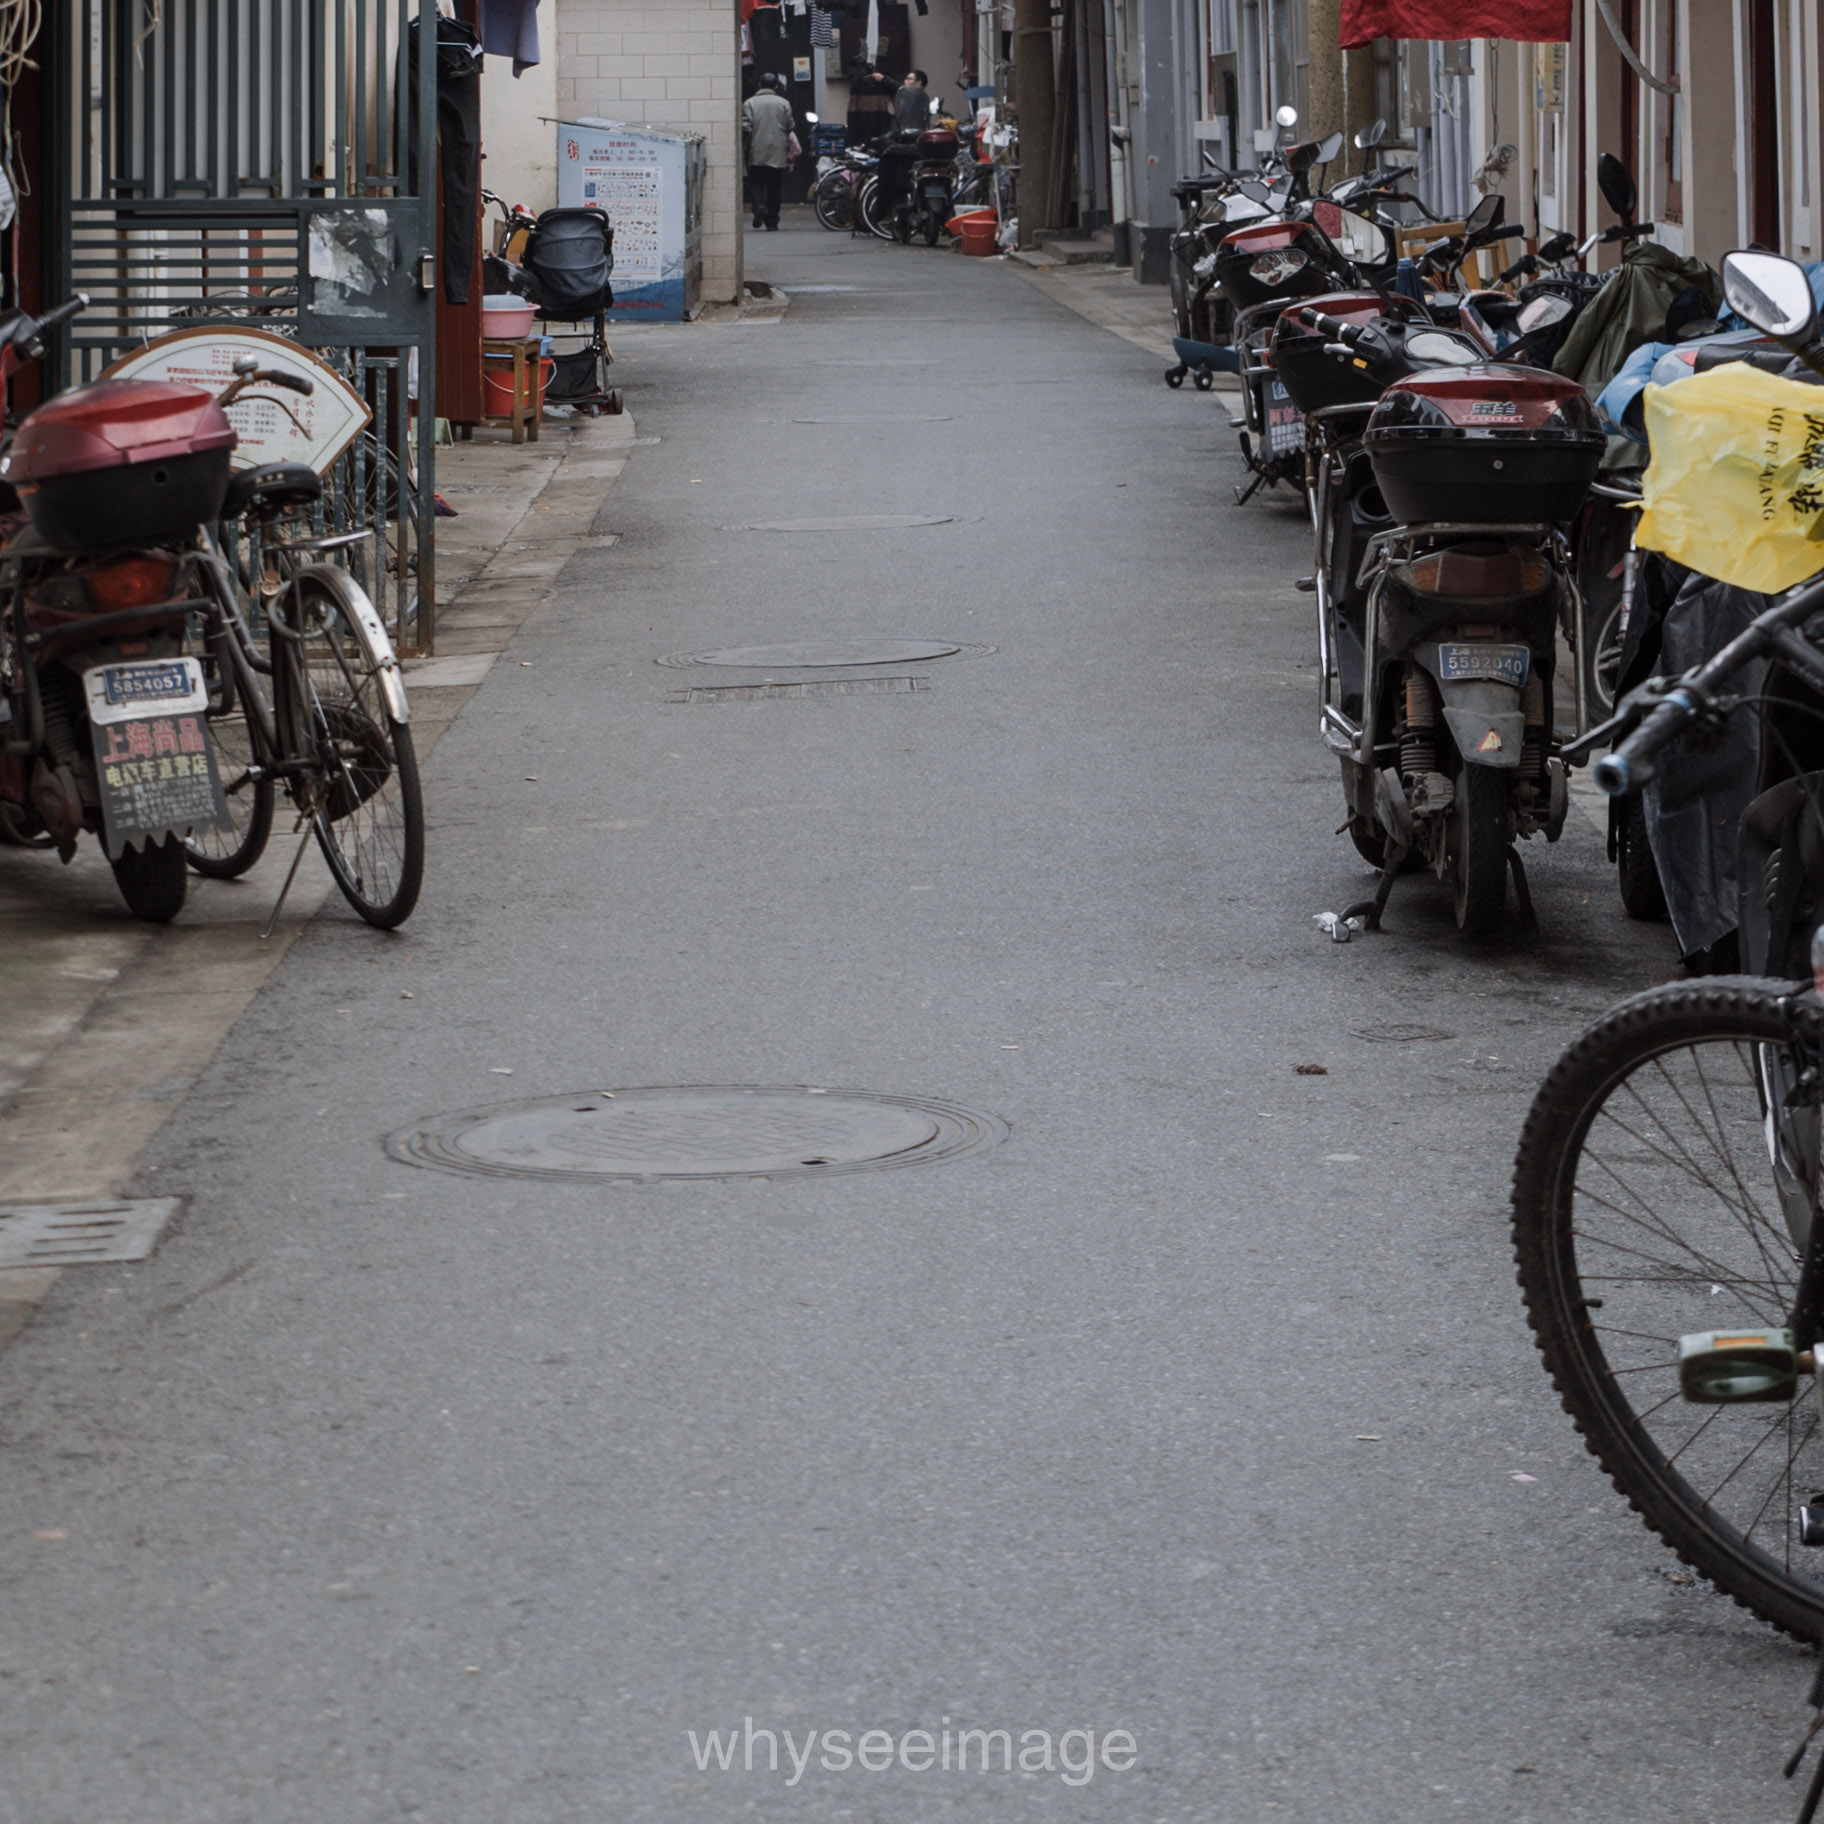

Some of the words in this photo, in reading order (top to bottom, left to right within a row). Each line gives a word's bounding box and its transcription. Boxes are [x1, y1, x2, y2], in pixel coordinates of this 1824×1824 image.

[1448, 656, 1523, 675] 5592040
[113, 674, 184, 694] 5854057
[102, 716, 206, 764] 上海尚品
